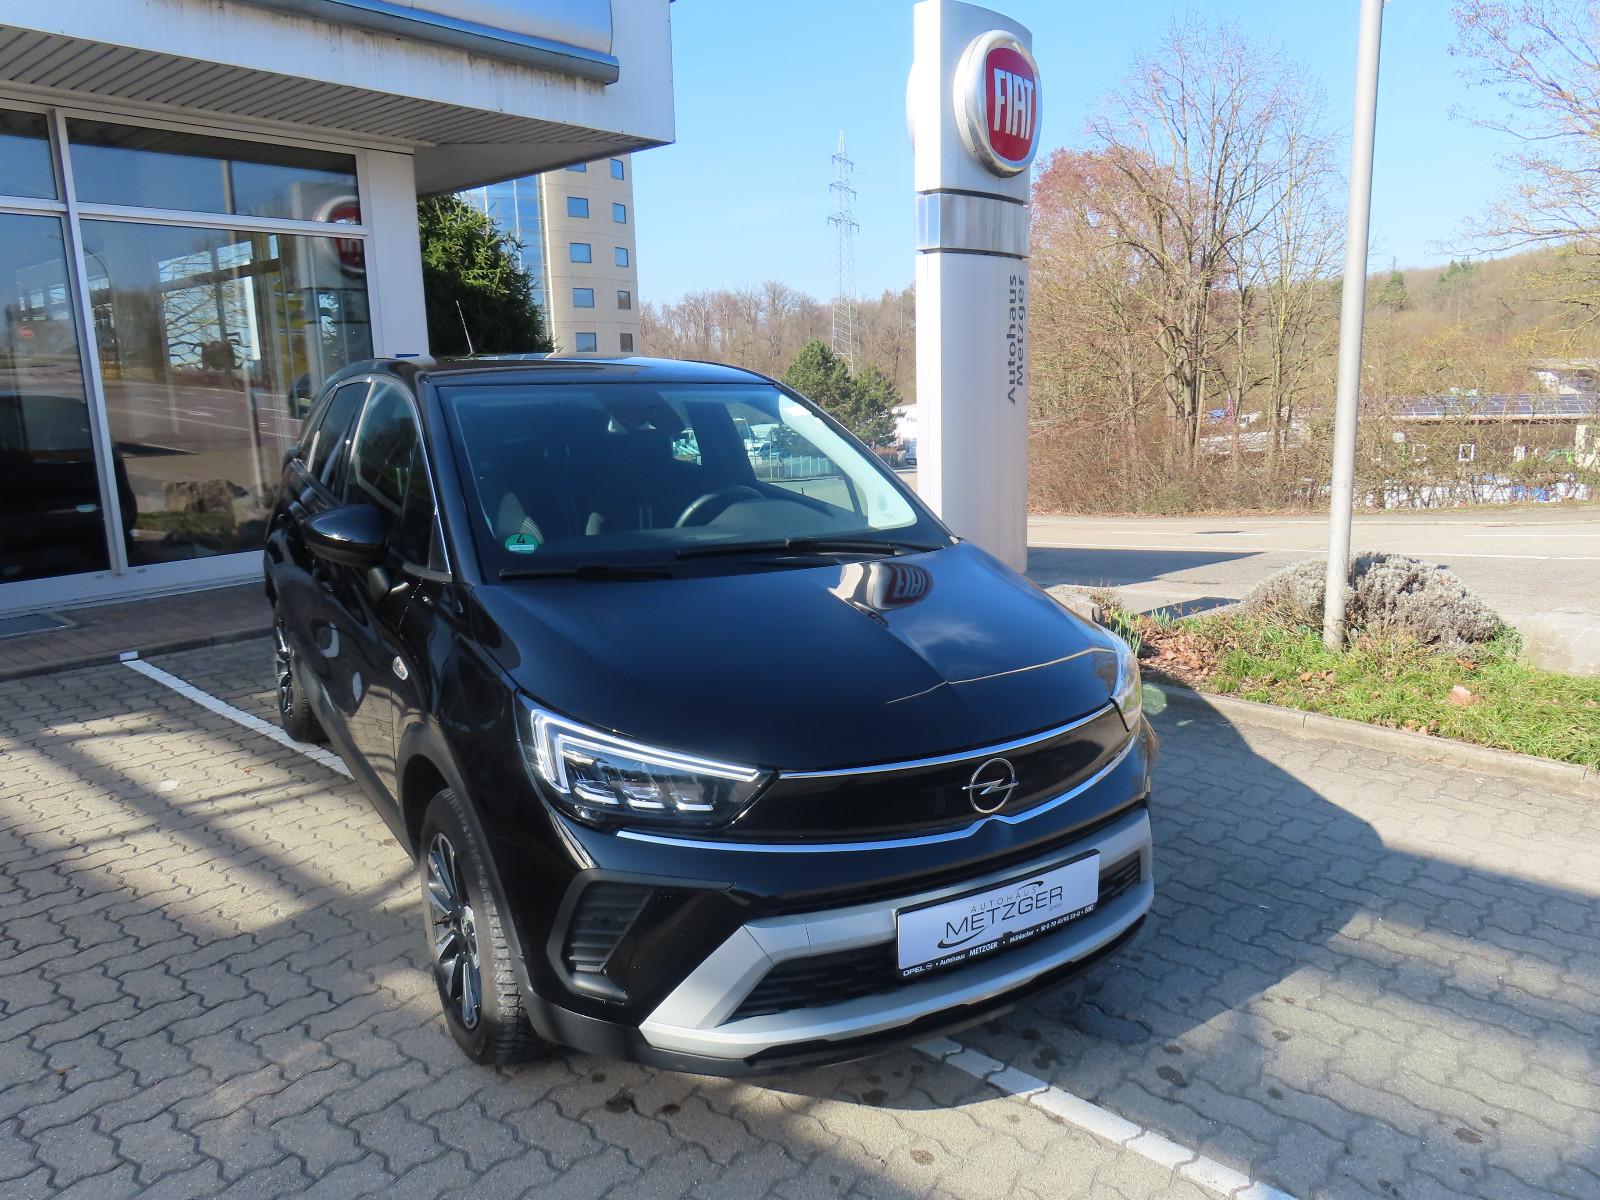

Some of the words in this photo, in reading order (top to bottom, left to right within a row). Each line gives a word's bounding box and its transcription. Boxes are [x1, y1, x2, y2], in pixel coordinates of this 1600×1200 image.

[993, 68, 1034, 140] FIAT
[1006, 274, 1016, 405] Autohaus
[1016, 275, 1026, 386] Metzger
[516, 535, 526, 544] 4
[946, 885, 1063, 938] METZGER
[970, 886, 1037, 913] AUTOHAUS
[902, 965, 926, 977] OPEL
[939, 953, 966, 966] Autohaus
[969, 941, 999, 957] METZGER
